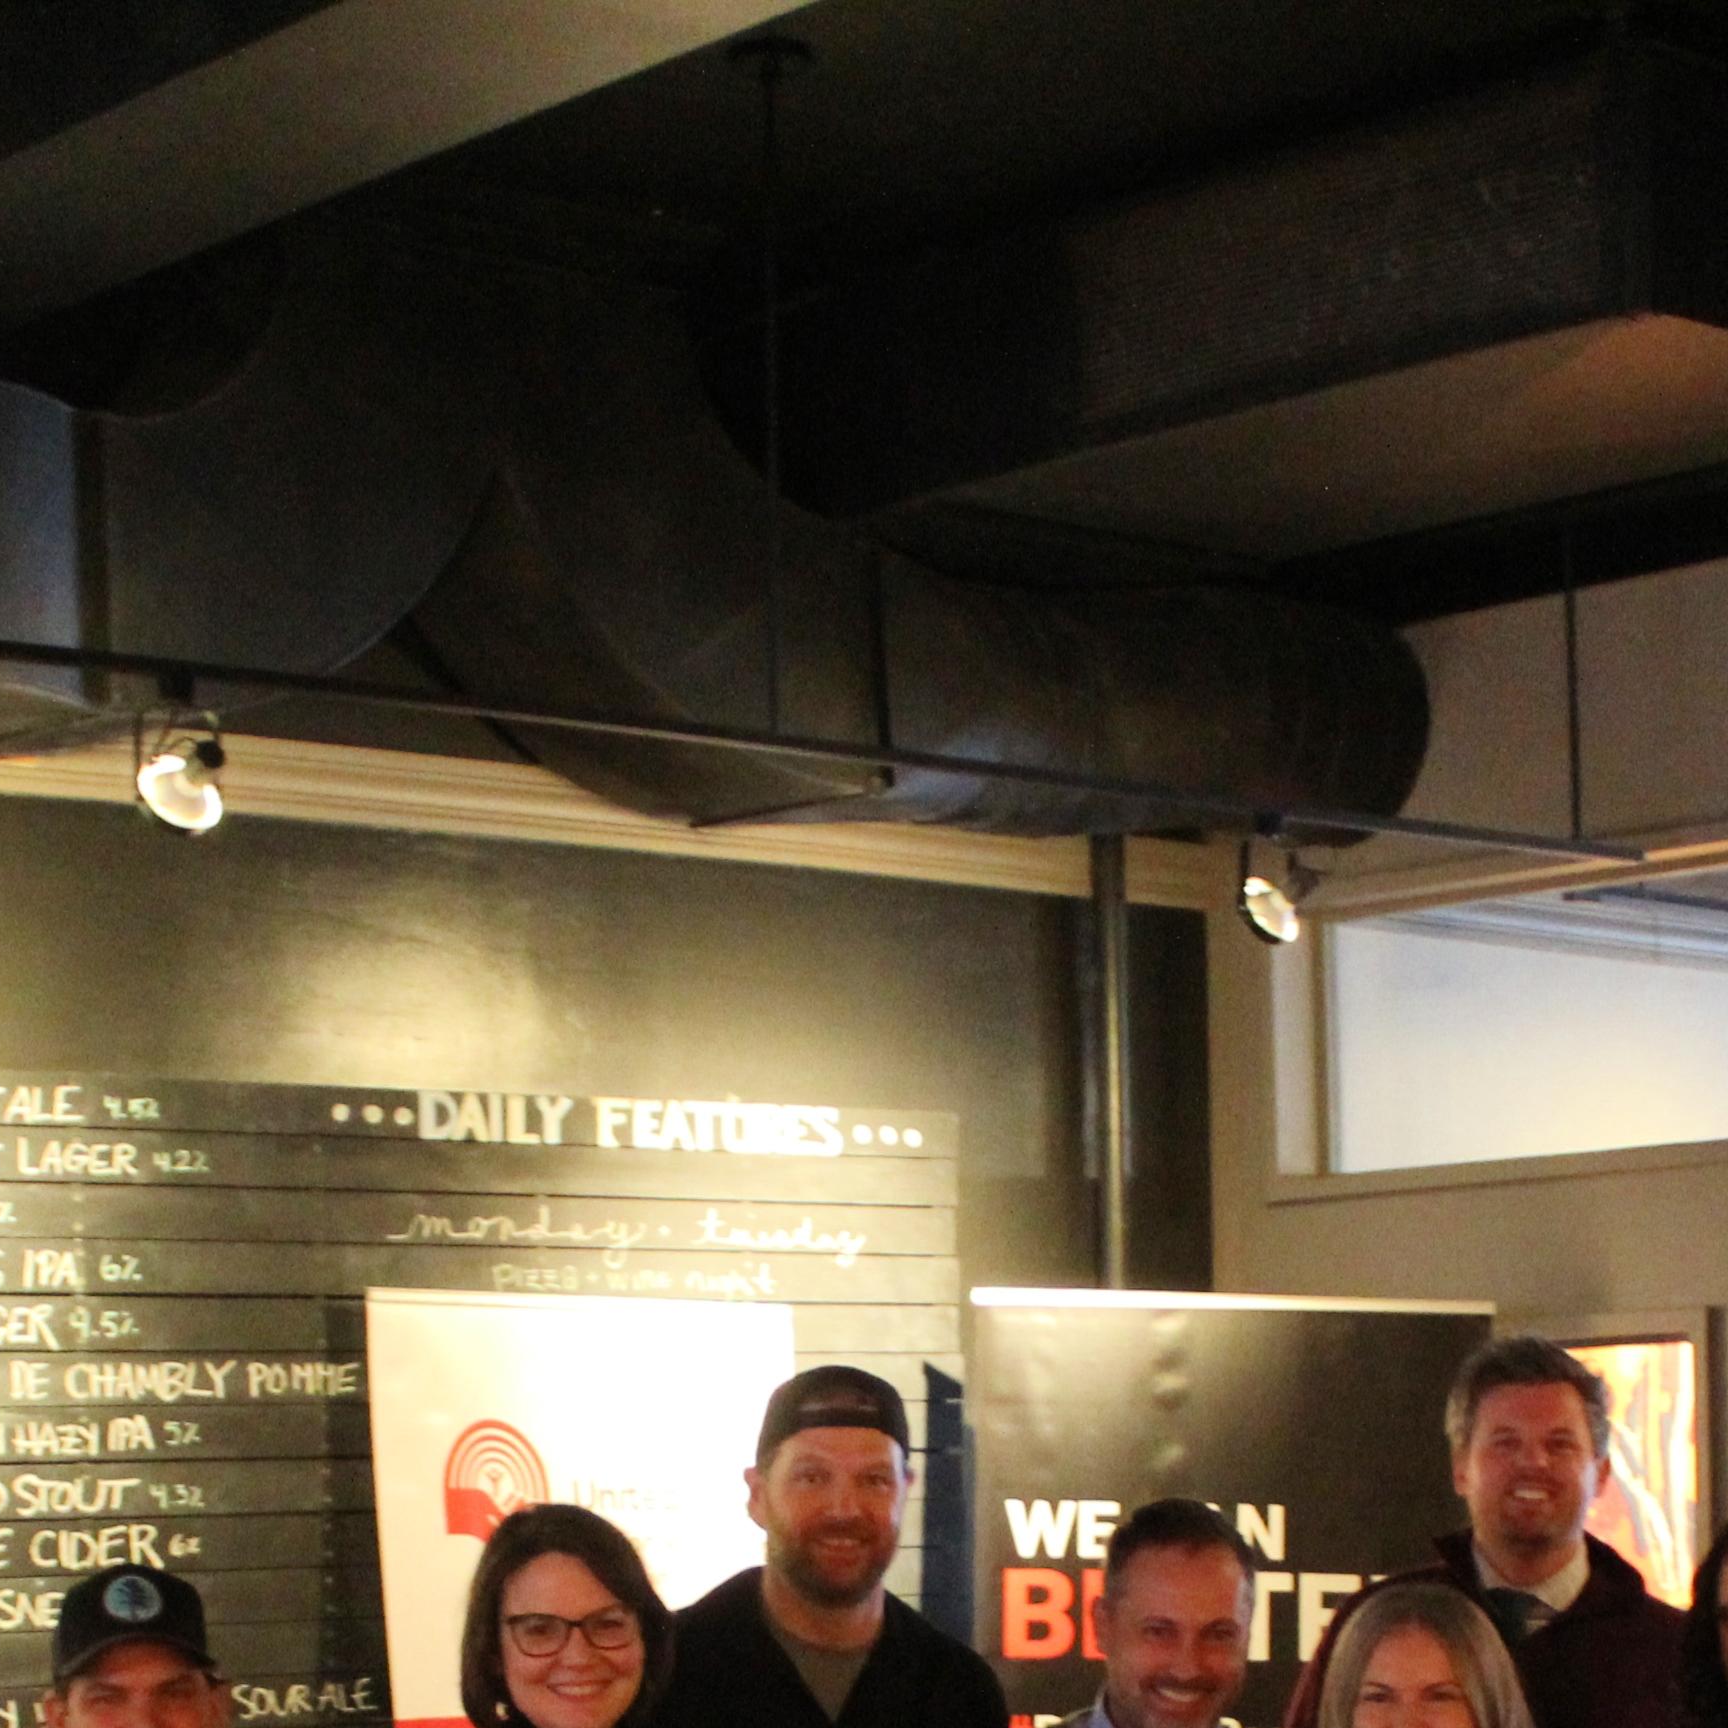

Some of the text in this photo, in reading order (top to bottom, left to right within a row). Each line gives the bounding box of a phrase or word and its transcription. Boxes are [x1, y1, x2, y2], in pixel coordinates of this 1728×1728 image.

[4, 1085, 85, 1124] ALE
[418, 1088, 843, 1158] DAILY FEATURES
[16, 1137, 138, 1176] LAGER
[23, 1249, 81, 1290] IPA
[9, 1360, 50, 1400] DE
[64, 1360, 237, 1402] CHAMBLY
[247, 1361, 360, 1398] POMME
[12, 1421, 100, 1457] HAZY
[107, 1414, 156, 1451] IPA
[12, 1473, 143, 1518] STOUT
[29, 1524, 165, 1569] CIDER
[231, 1683, 313, 1720] SOUR
[318, 1678, 378, 1714] ALE
